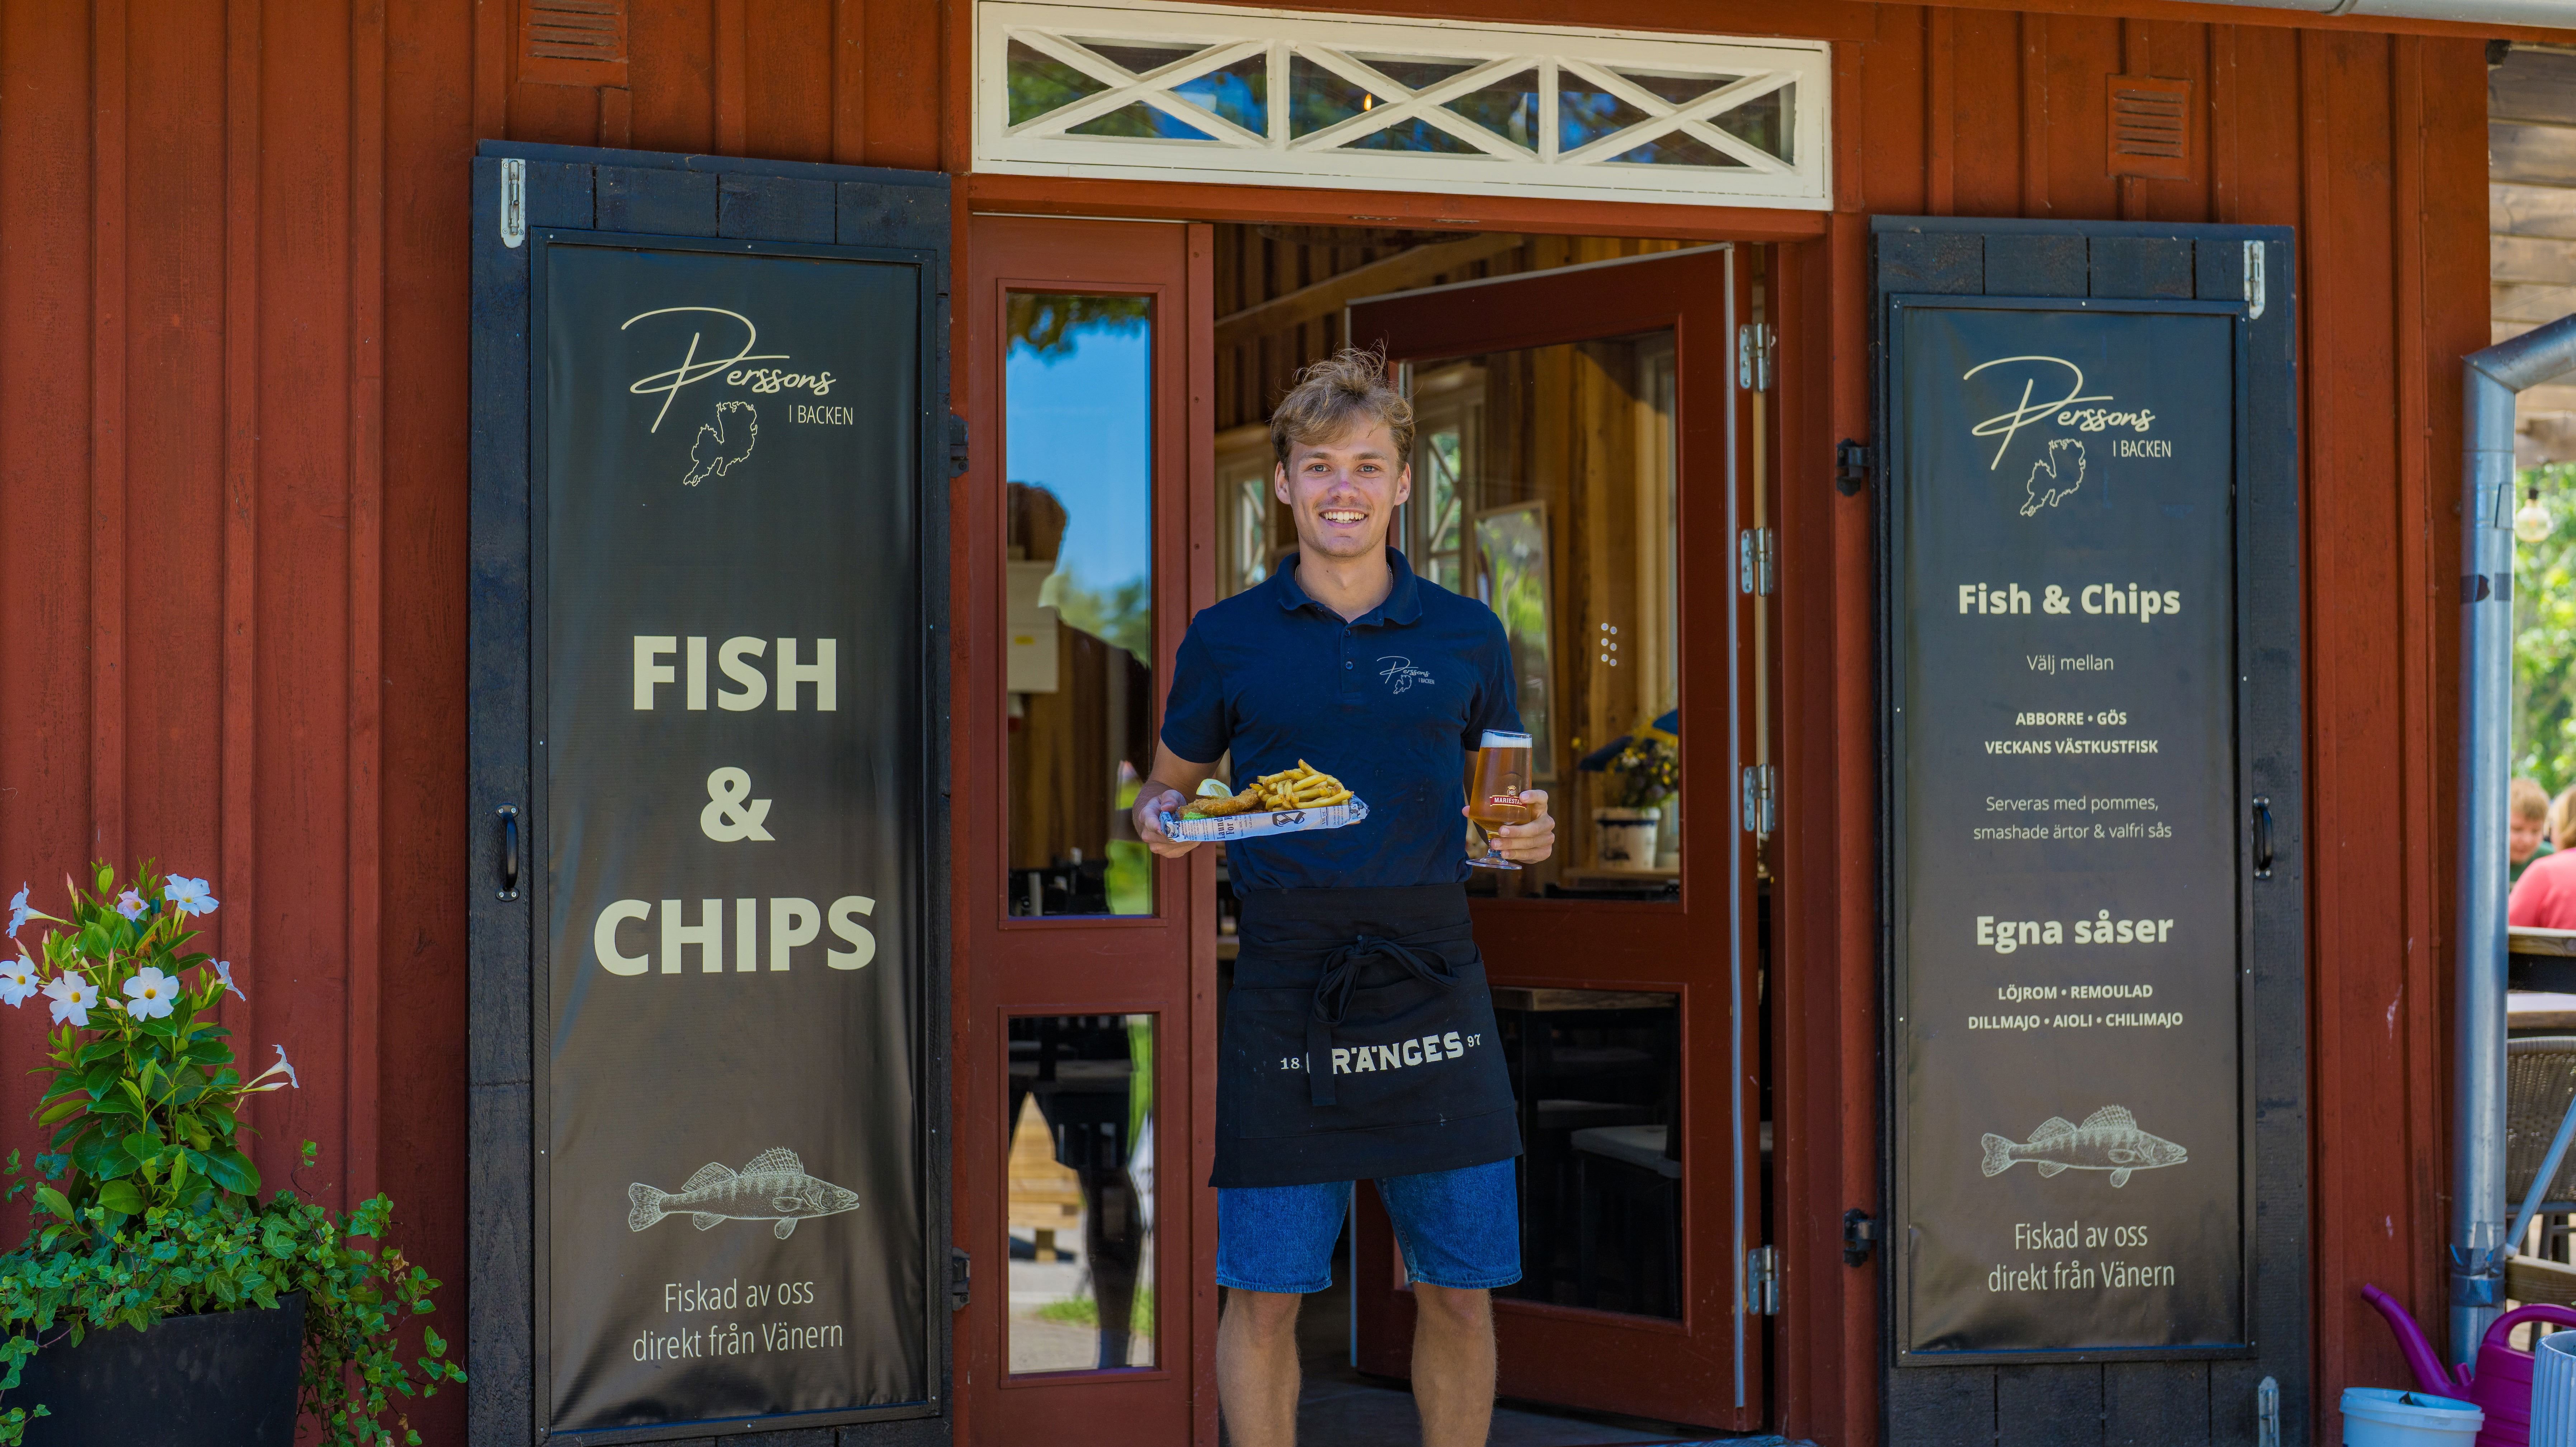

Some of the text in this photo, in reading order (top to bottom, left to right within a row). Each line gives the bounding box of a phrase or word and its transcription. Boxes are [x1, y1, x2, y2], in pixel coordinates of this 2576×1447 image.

[621, 307, 836, 433] Perssons
[789, 405, 852, 425] I BACKEN
[1963, 355, 2156, 470] Perssons
[2113, 440, 2171, 457] I BACKEN
[1959, 583, 2180, 623] Fish & Chips
[634, 636, 836, 711] FISH
[1377, 656, 1430, 684] Perssons
[2027, 654, 2113, 675] Välj mellan
[2016, 709, 2127, 725] ABBORRE GÖS
[1985, 738, 2158, 754] VECKANS VÄSTKUSTFISK
[701, 767, 775, 842] &
[1987, 796, 2158, 813] Serveras med pommes,
[1226, 823, 1234, 835] For
[1974, 822, 2171, 840] smashade ärtor & valfri sås
[594, 896, 875, 976] CHIPS
[1977, 909, 2173, 954] Egna såser
[1999, 984, 2152, 1002] LÖJROM REMOULAD
[1969, 1012, 2182, 1031] DILLMAJO AIOLI CHILIMAJO
[1281, 1031, 1480, 1074] 18 RÄNGES 97
[2016, 1221, 2147, 1249] Fiskad av oss
[1989, 1260, 2174, 1292] direkt från Vänern
[666, 1278, 813, 1312] Fiskad av oss
[634, 1322, 842, 1361] direkt från Vänern
